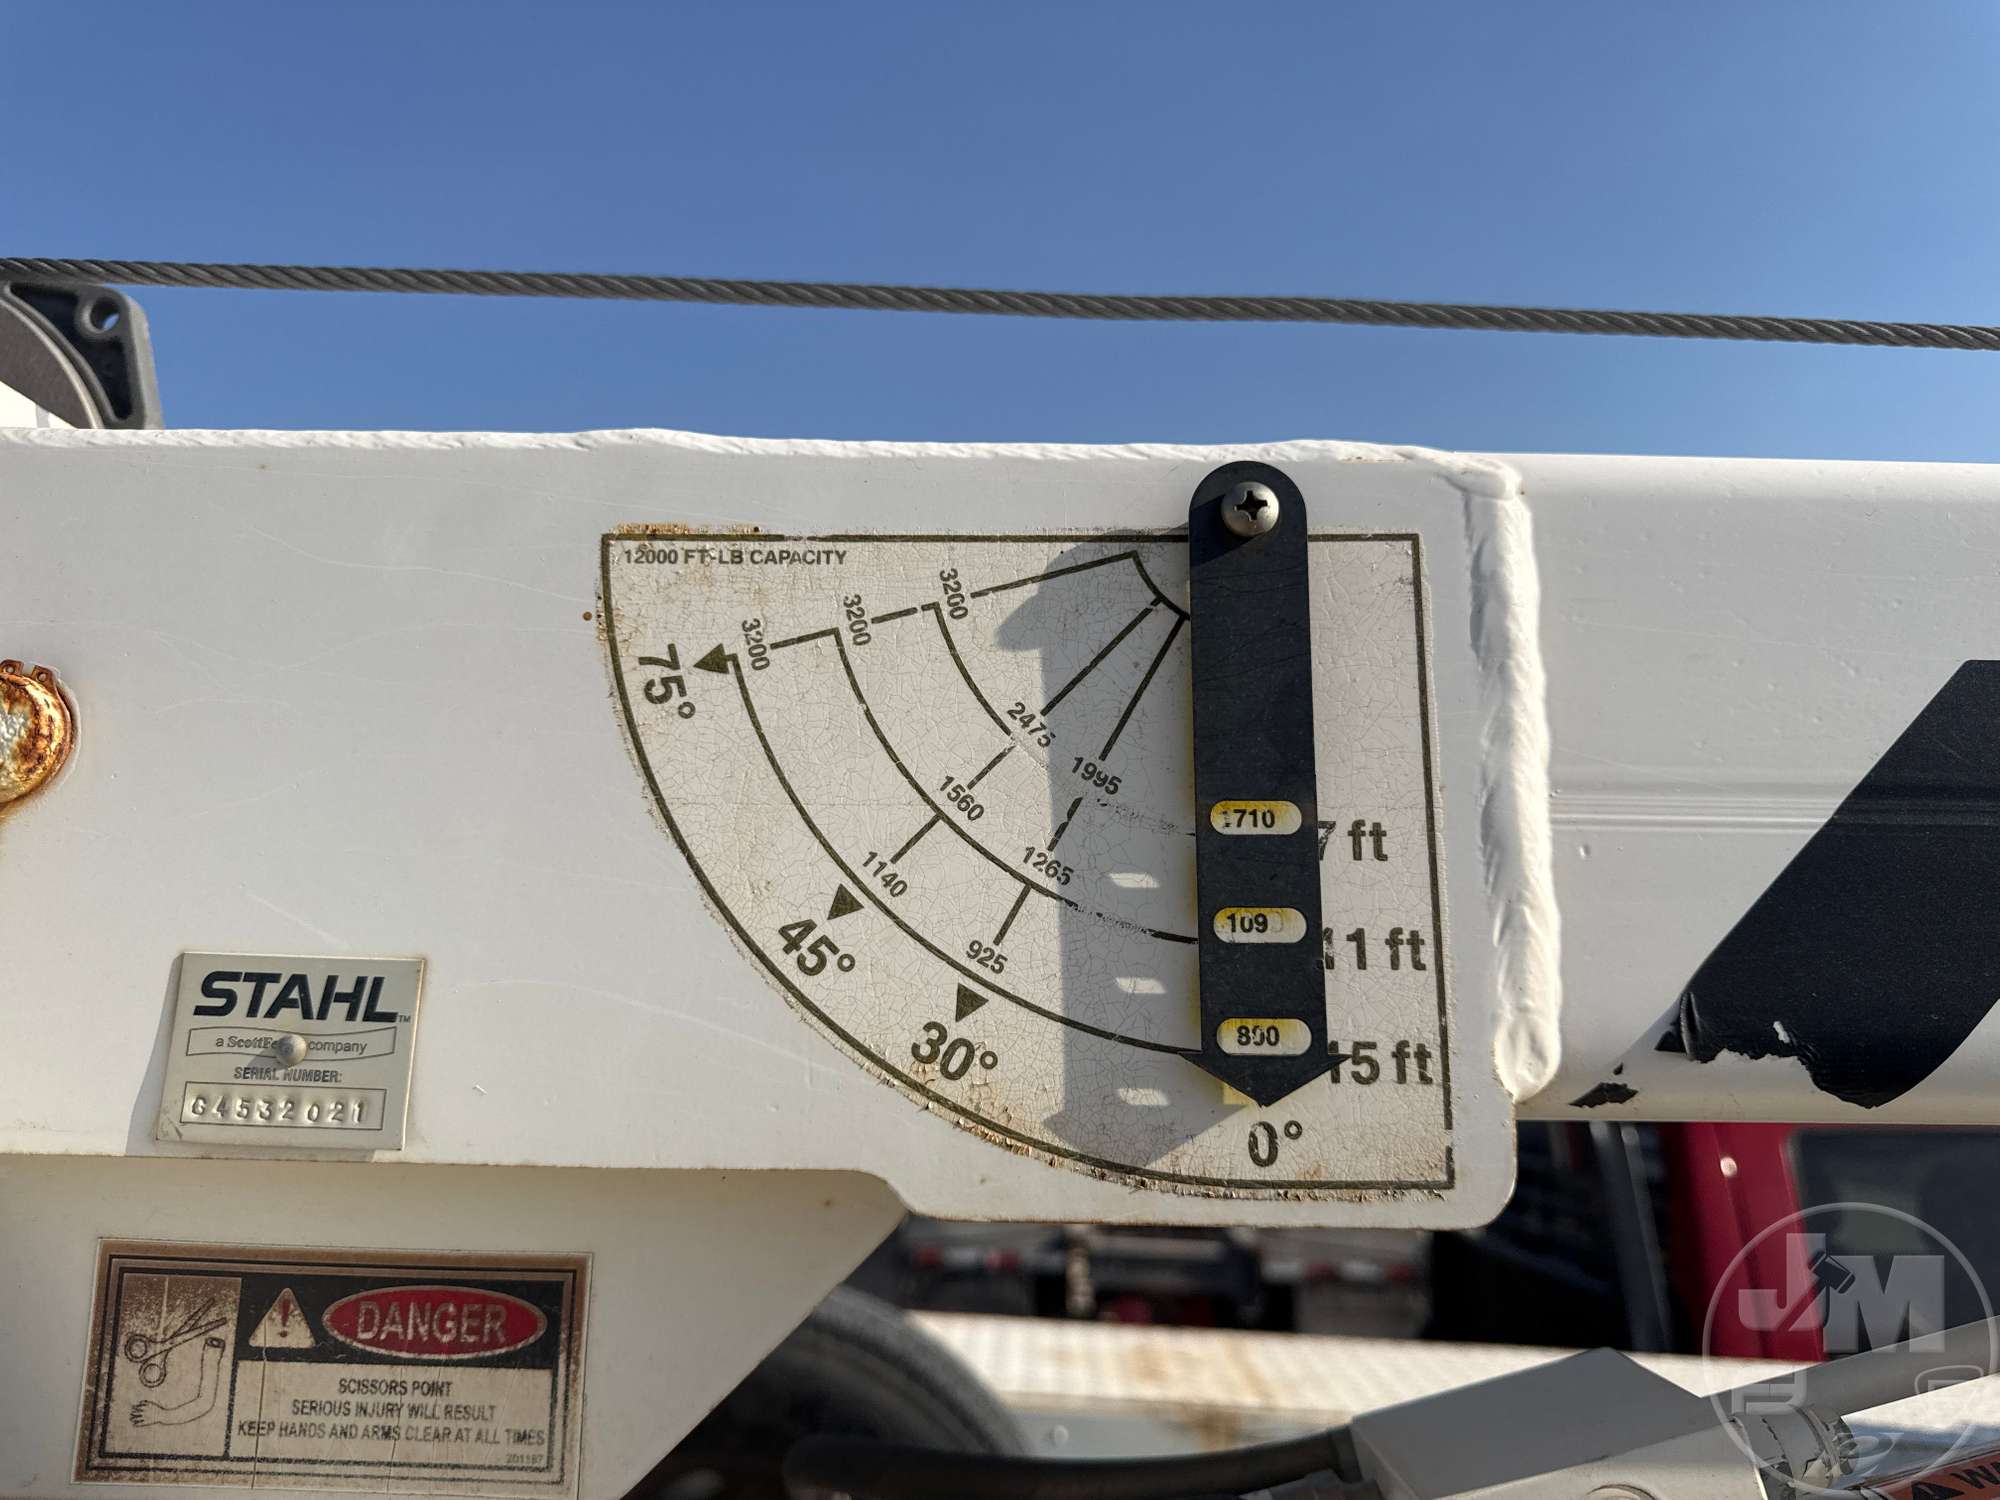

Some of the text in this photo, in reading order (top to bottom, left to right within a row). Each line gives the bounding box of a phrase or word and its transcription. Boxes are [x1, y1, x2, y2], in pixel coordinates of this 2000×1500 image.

[623, 549, 847, 566] 12000 FT-LB CAPACITY
[939, 567, 969, 620] 3200
[843, 594, 872, 647] 3200
[740, 618, 770, 671] 3200
[637, 643, 696, 719] 75°
[1006, 701, 1055, 748] 2475
[1071, 756, 1122, 796] 1995
[939, 775, 985, 822] 1560
[1348, 819, 1388, 862] ft
[861, 850, 907, 898] 1140
[1023, 845, 1074, 886] 1265
[778, 918, 856, 976] 45°
[966, 939, 1008, 974] 925
[1385, 927, 1426, 971] ft
[193, 970, 398, 1023] STAHL
[216, 1037, 224, 1047] a
[308, 1040, 367, 1055] company
[911, 1021, 998, 1081] 30°
[1328, 1040, 1433, 1085] 15 ft
[234, 1066, 280, 1081] SERIAL
[1248, 1120, 1303, 1168] 0°
[357, 1301, 507, 1343] DANGER
[338, 1378, 453, 1397] SCISSORS POINT
[291, 1399, 496, 1422] SERIOUS INJURY WILL RESULT
[237, 1420, 545, 1447] KEEP HANDS AND ARMS CLEAR AT ALL TIMES
